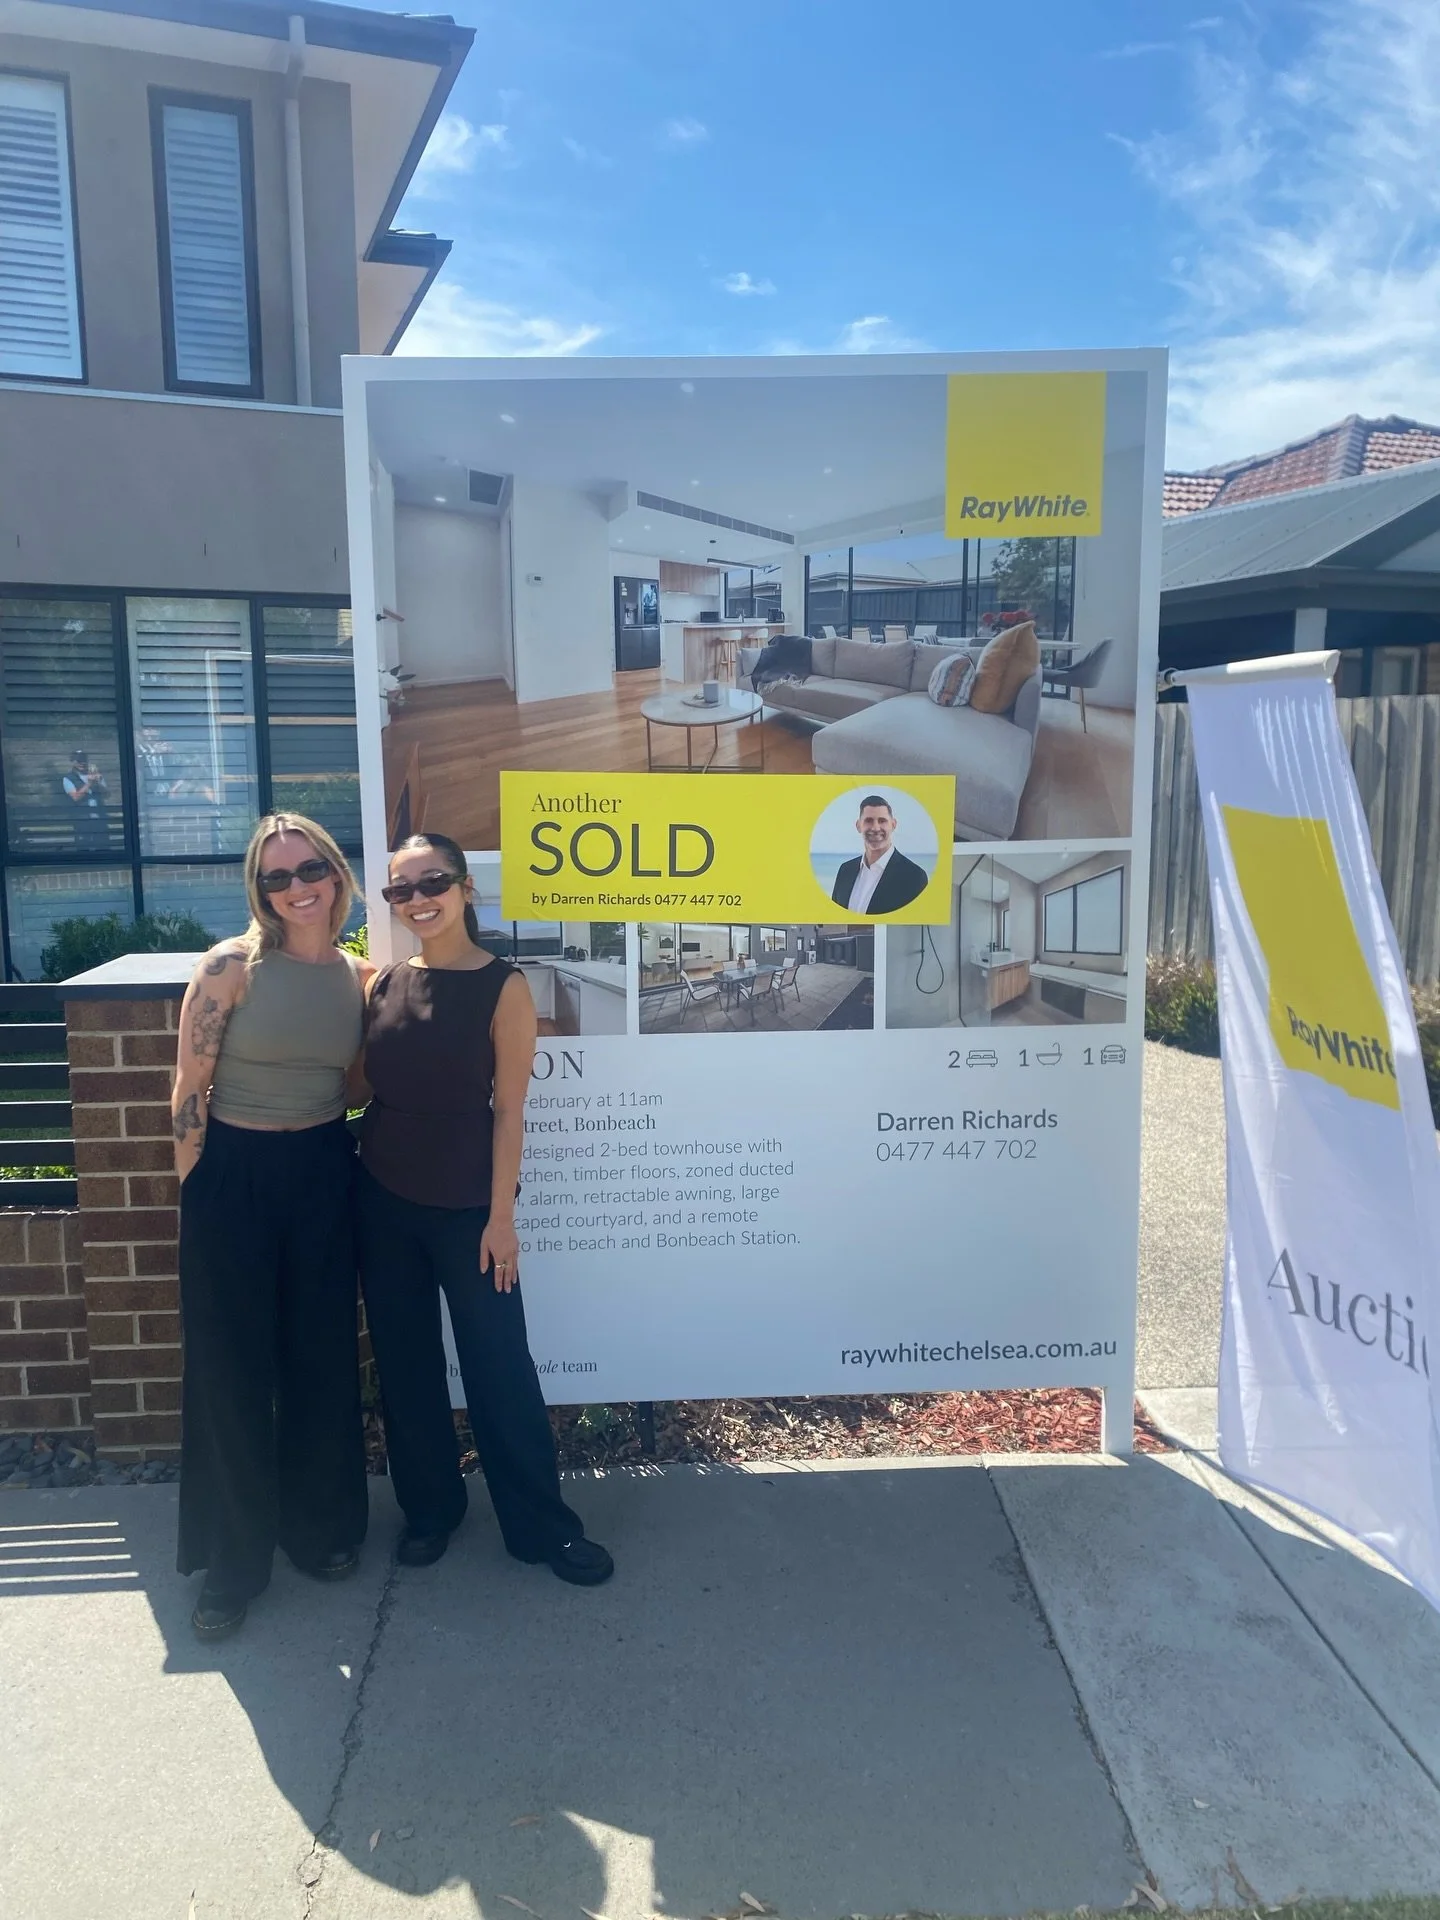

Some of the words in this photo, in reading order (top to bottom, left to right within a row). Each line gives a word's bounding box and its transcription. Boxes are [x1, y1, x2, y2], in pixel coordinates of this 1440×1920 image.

[531, 793, 622, 814] Another
[529, 820, 716, 879] SOLD
[532, 892, 548, 907] by
[551, 892, 594, 906] Darren
[598, 892, 651, 906] Richards
[654, 894, 688, 906] 0477
[690, 894, 715, 906] 447
[718, 894, 742, 907] 702
[947, 1050, 961, 1069] 2
[1018, 1048, 1030, 1067] 1
[1083, 1047, 1095, 1066] 1
[596, 1093, 613, 1107] at
[618, 1092, 663, 1107] 11am
[574, 1114, 656, 1132] Bonbeach
[876, 1111, 954, 1132] Darren
[962, 1109, 1058, 1130] Richards
[522, 1143, 594, 1162] designed
[600, 1141, 648, 1157] 2-bed
[654, 1139, 743, 1156] townhouse
[748, 1138, 783, 1153] with
[876, 1141, 935, 1162] 0477
[942, 1140, 986, 1160] 447
[996, 1139, 1038, 1160] 702
[573, 1165, 625, 1182] timber
[631, 1164, 680, 1180] floors,
[686, 1162, 734, 1178] zoned
[739, 1160, 794, 1177] ducted
[530, 1190, 578, 1206] alarm,
[584, 1187, 670, 1204] retractable
[675, 1186, 736, 1203] awning,
[741, 1185, 780, 1202] large
[566, 1211, 647, 1229] courtyard,
[652, 1209, 682, 1225] and
[687, 1213, 696, 1224] a
[701, 1208, 758, 1224] remote
[537, 1237, 563, 1252] the
[568, 1235, 616, 1250] beach
[621, 1233, 650, 1249] and
[656, 1231, 735, 1248] Bonbeach
[741, 1230, 801, 1245] Station.
[840, 1339, 1118, 1368] raywhitechelsea.com.au
[562, 1360, 598, 1374] team
